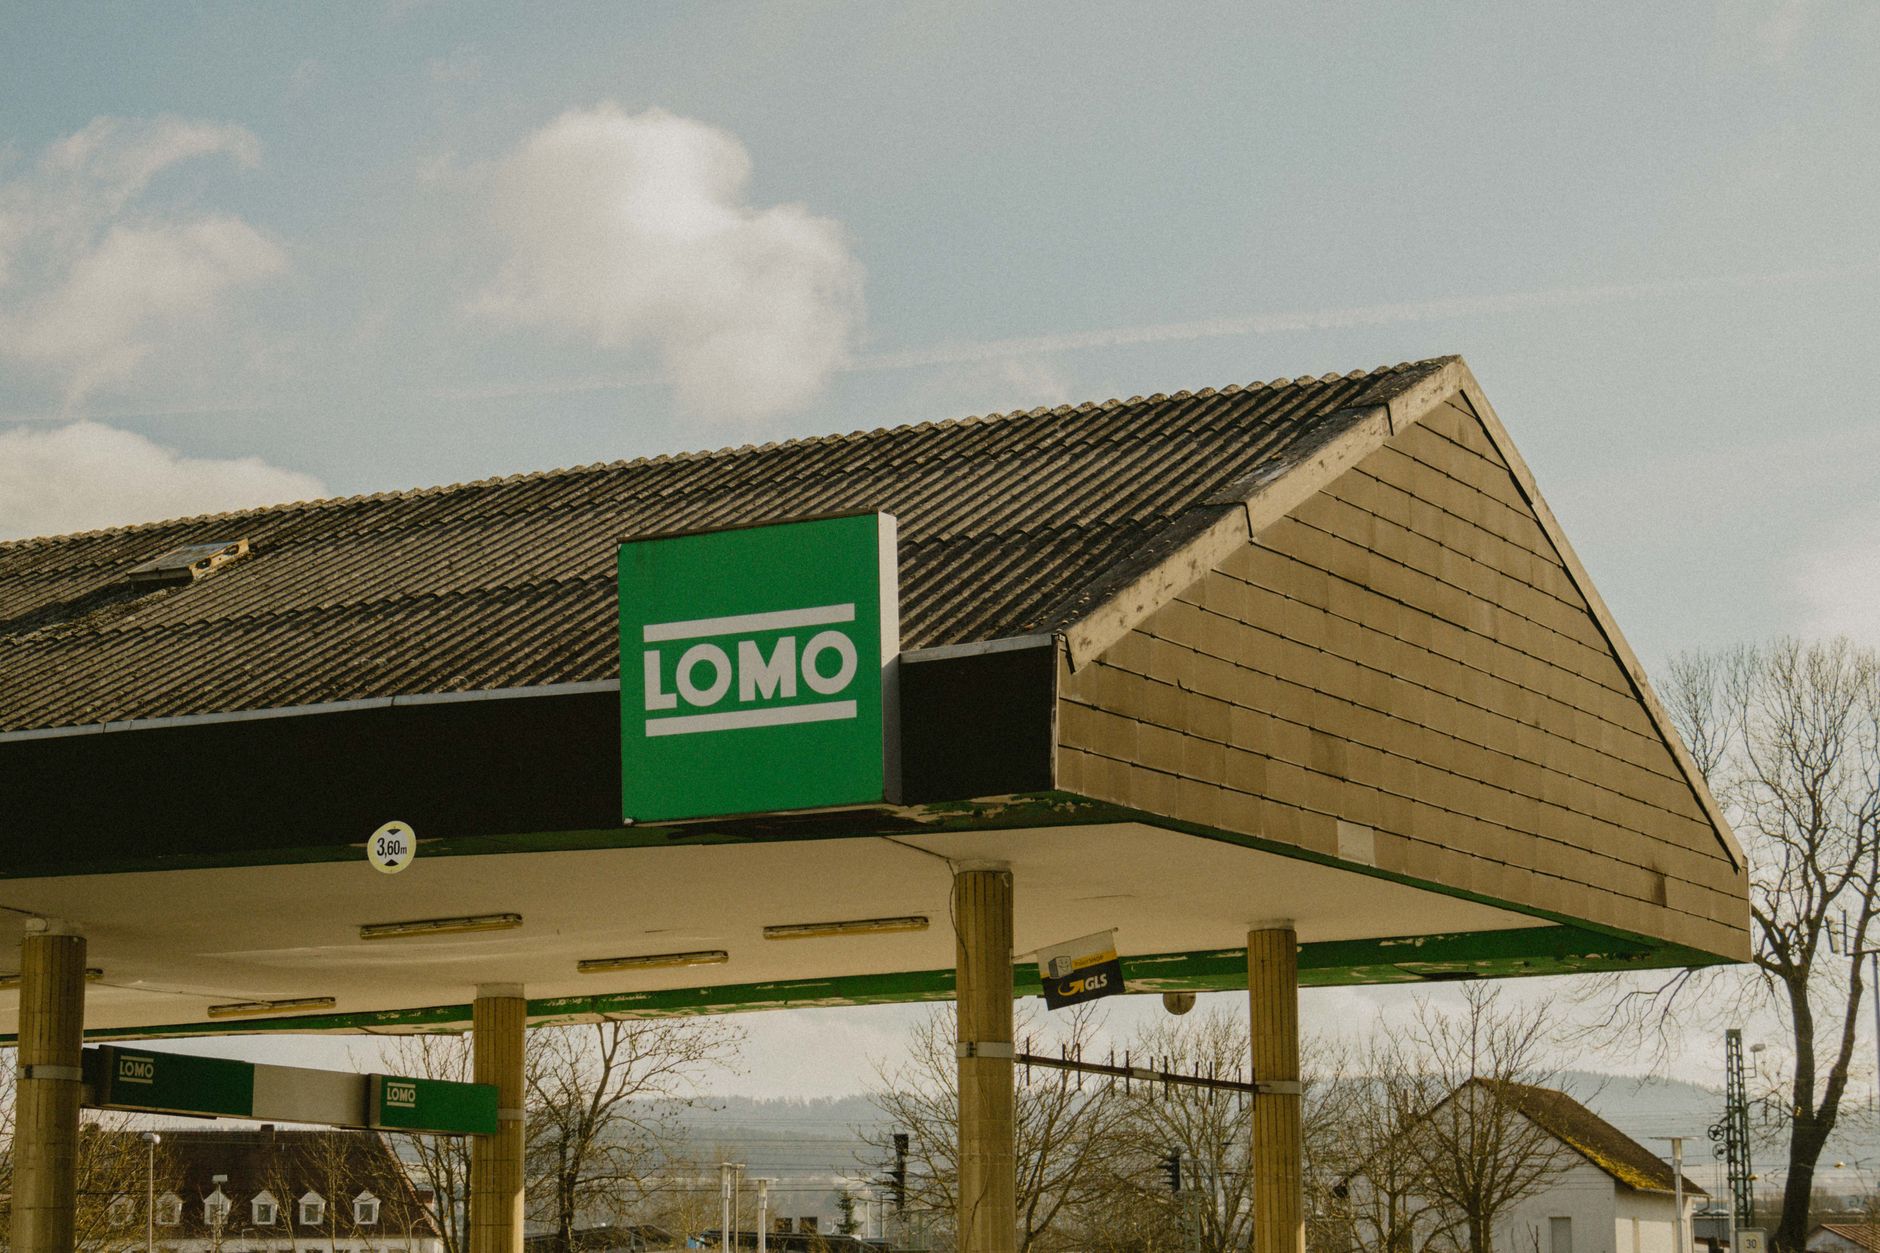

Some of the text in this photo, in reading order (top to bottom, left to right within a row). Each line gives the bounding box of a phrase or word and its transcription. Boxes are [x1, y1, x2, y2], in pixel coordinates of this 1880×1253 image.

[643, 630, 858, 711] LOMO
[1084, 973, 1108, 991] GLS
[119, 1060, 154, 1079] LOMO
[386, 1087, 416, 1102] LOMO
[1745, 1238, 1757, 1249] 30
